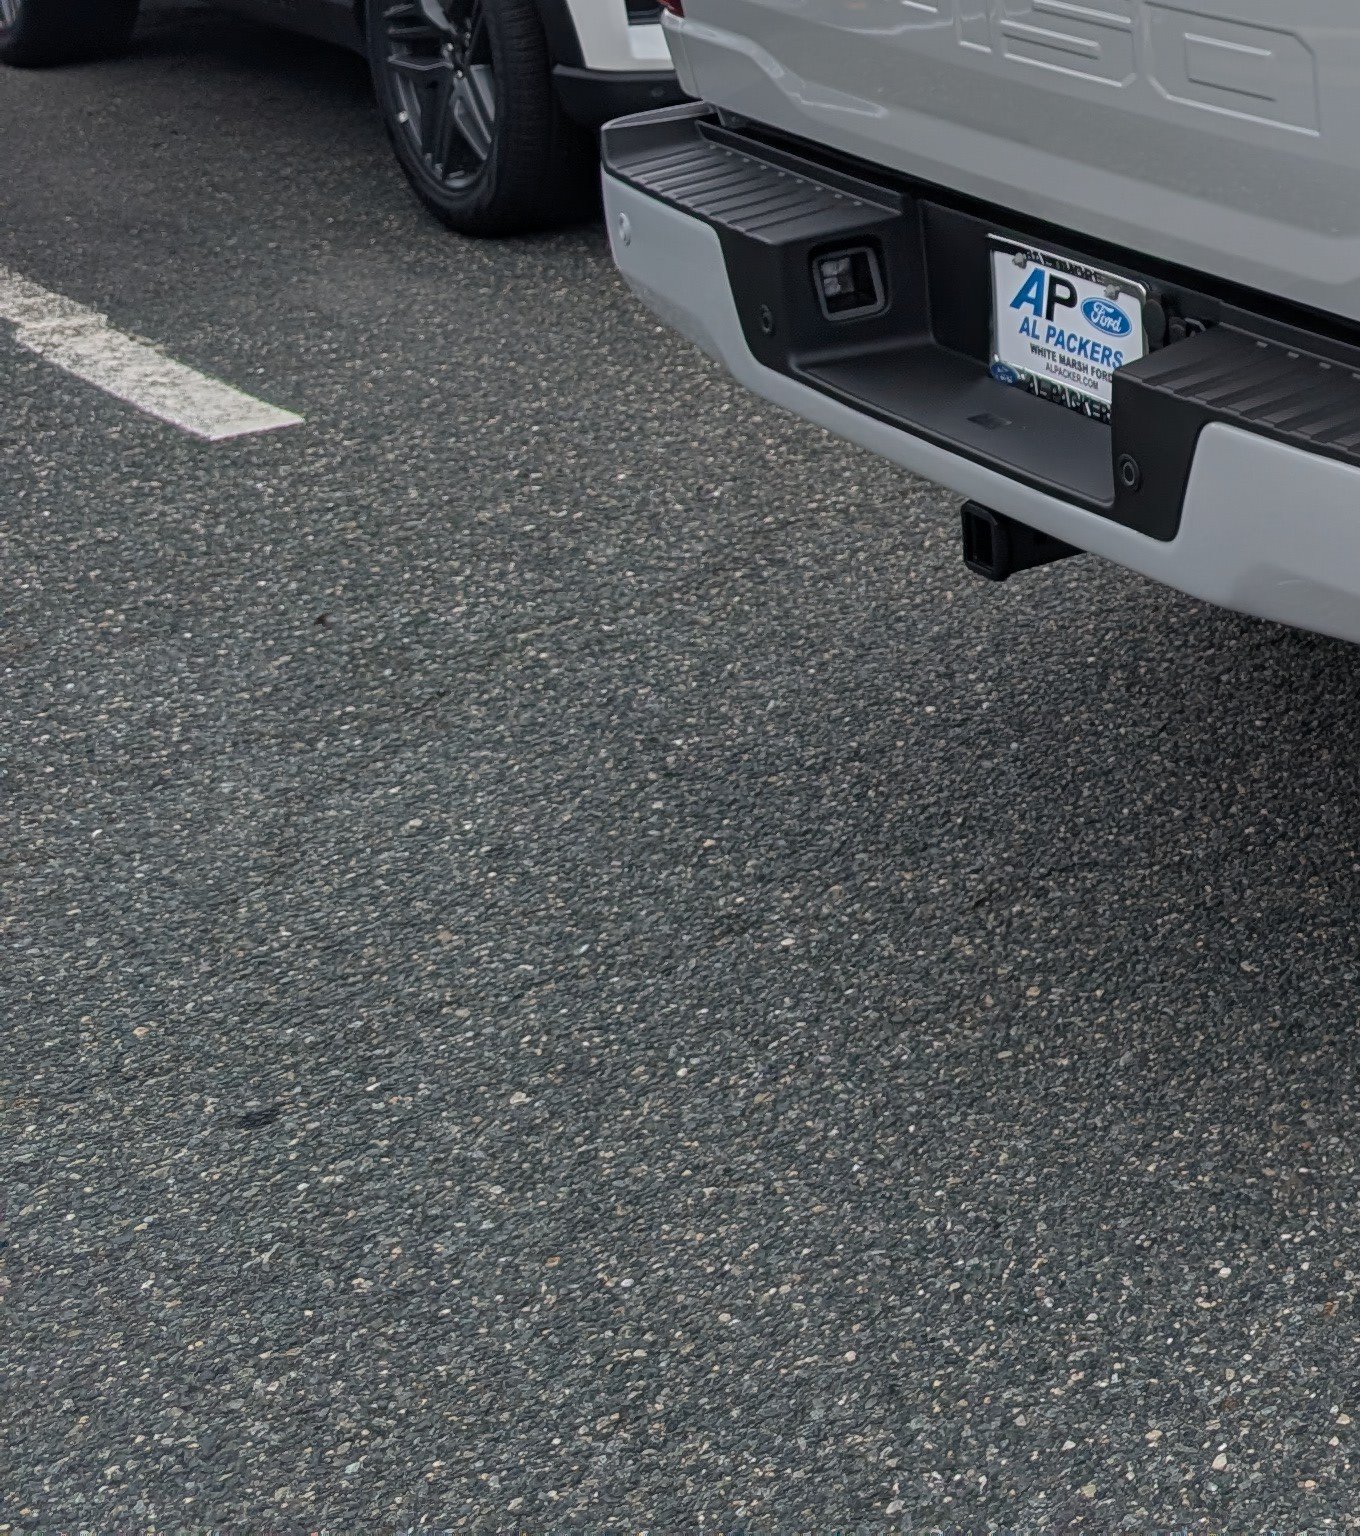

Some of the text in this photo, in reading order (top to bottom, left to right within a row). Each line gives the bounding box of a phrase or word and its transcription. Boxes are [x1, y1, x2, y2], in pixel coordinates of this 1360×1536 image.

[1010, 268, 1077, 322] AP
[1091, 301, 1123, 333] Ford
[1019, 316, 1123, 369] AL PACKERS
[1030, 343, 1057, 363] WHITE
[1059, 354, 1089, 374] MARSH
[1045, 362, 1099, 389] ALPACKER.COM
